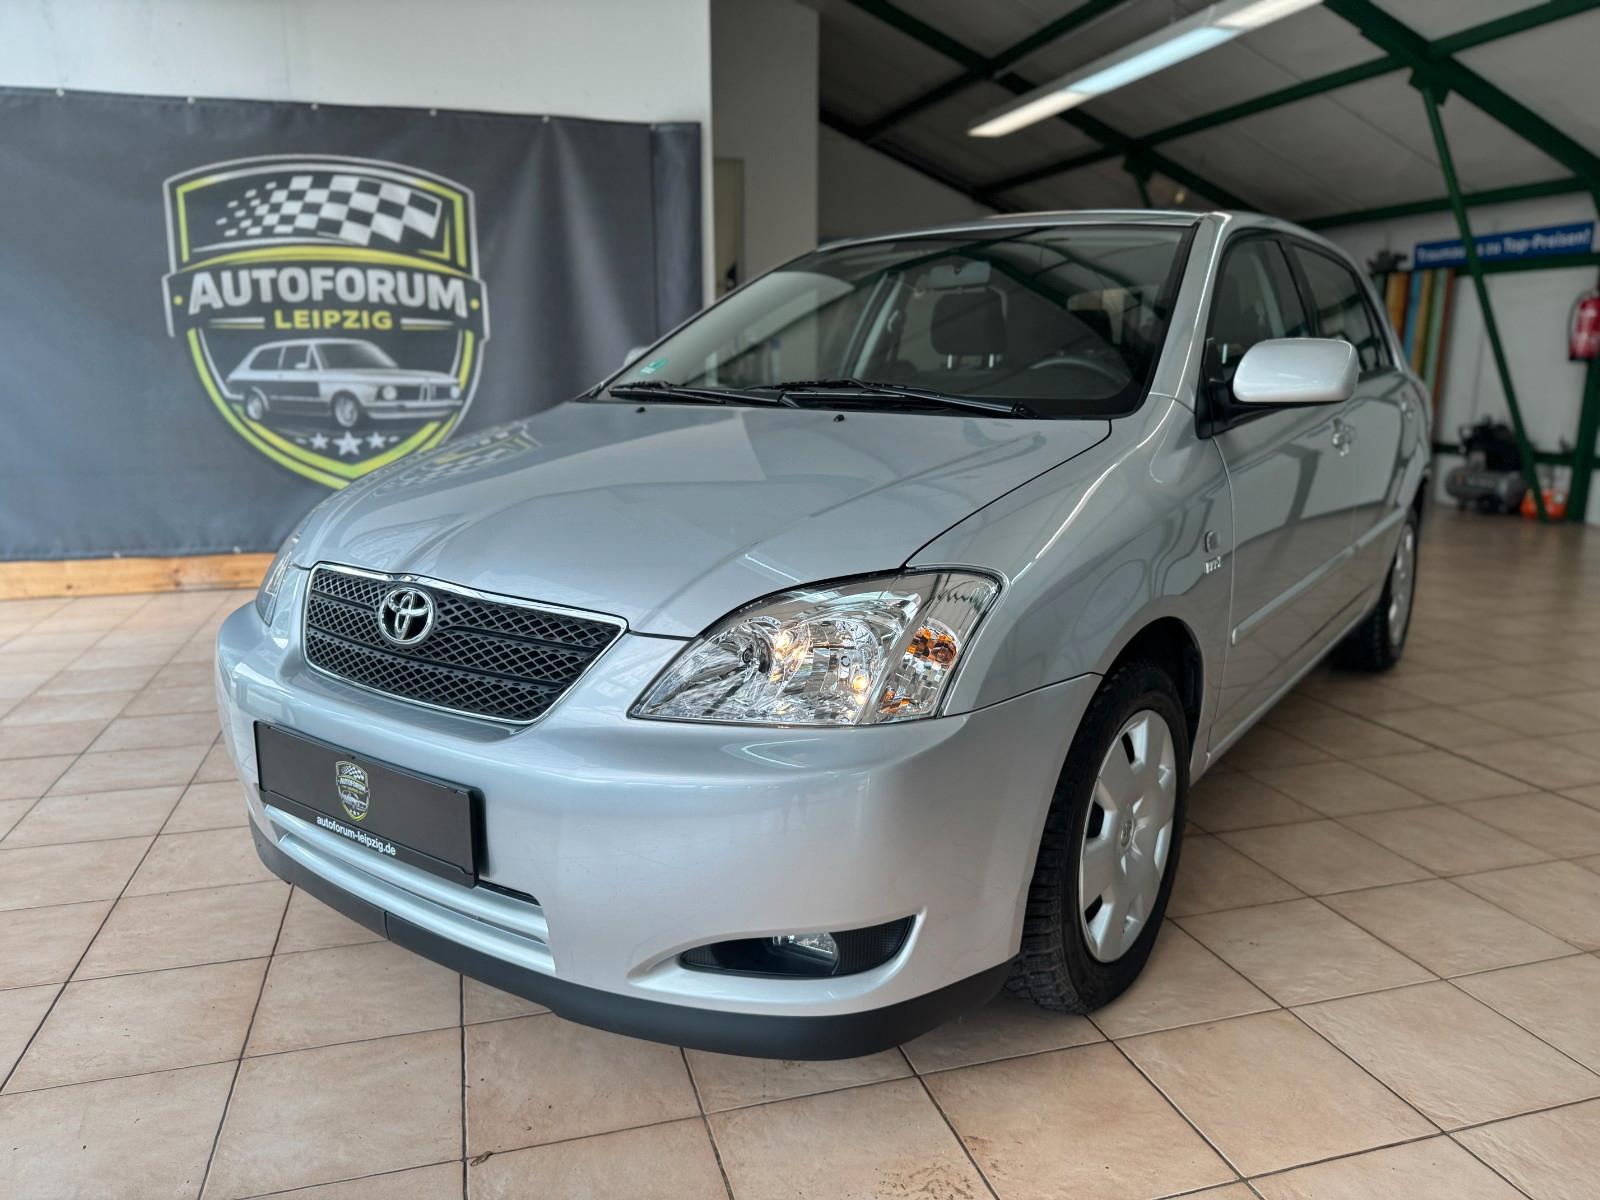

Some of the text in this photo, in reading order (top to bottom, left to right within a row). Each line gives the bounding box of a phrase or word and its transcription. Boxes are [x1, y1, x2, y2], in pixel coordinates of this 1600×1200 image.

[188, 267, 468, 319] AUTOFORUM
[274, 309, 393, 329] LEIPZIG
[316, 815, 396, 856] autoforum-leipzig.de
